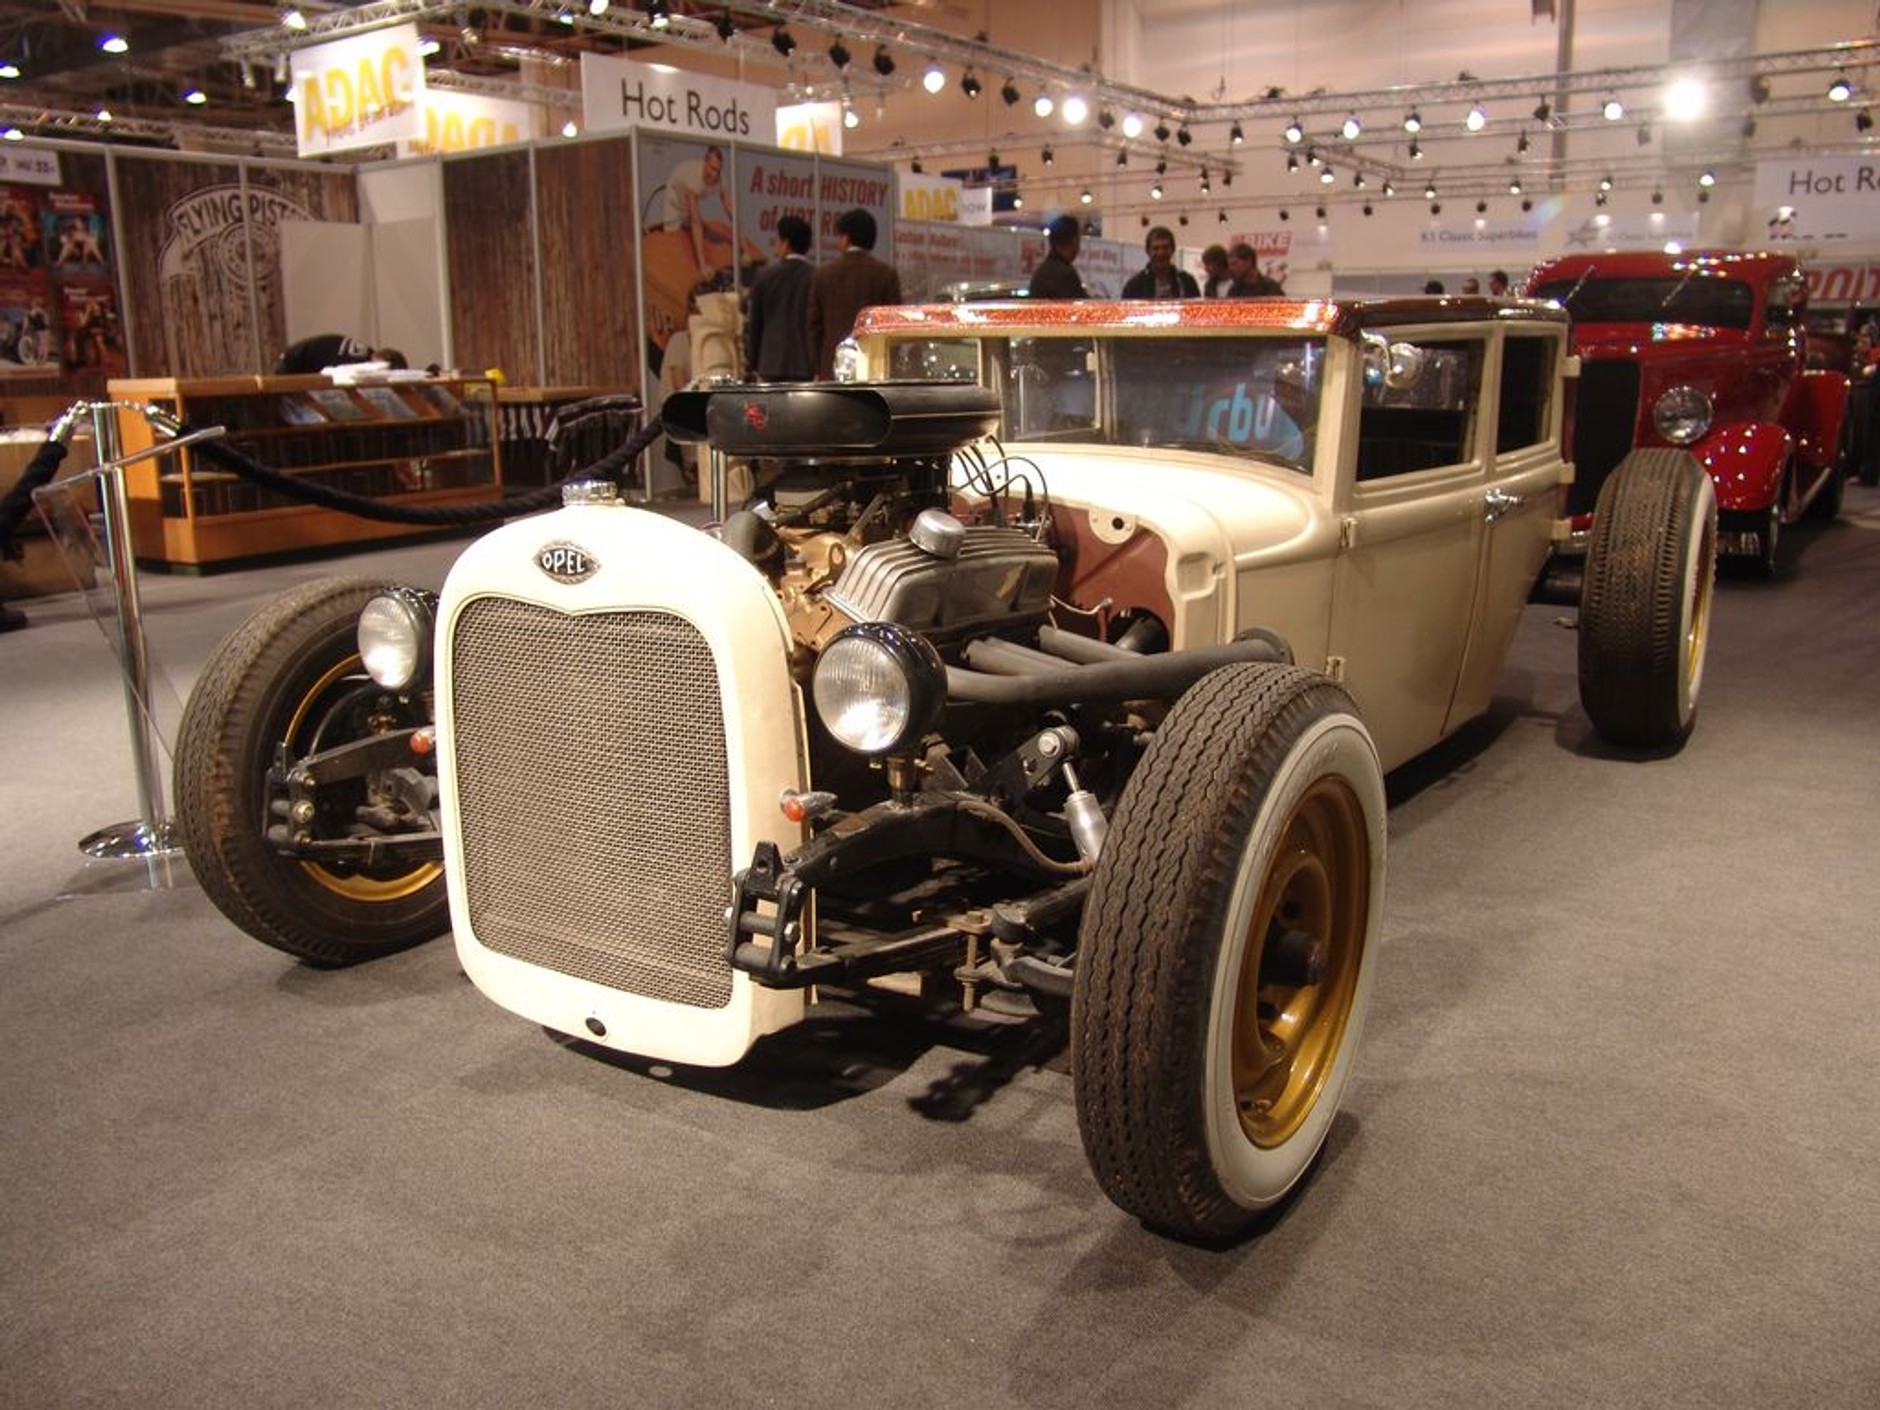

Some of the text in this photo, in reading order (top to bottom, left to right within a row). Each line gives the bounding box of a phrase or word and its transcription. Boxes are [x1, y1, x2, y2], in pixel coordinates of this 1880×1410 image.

[620, 78, 750, 136] Hot Rods
[750, 166, 890, 207] A short HISTORY
[1789, 169, 1845, 195] Hot
[176, 194, 306, 241] FLYING PIST
[759, 206, 778, 232] of
[904, 186, 958, 220] ADAC
[541, 549, 586, 574] OPEL
